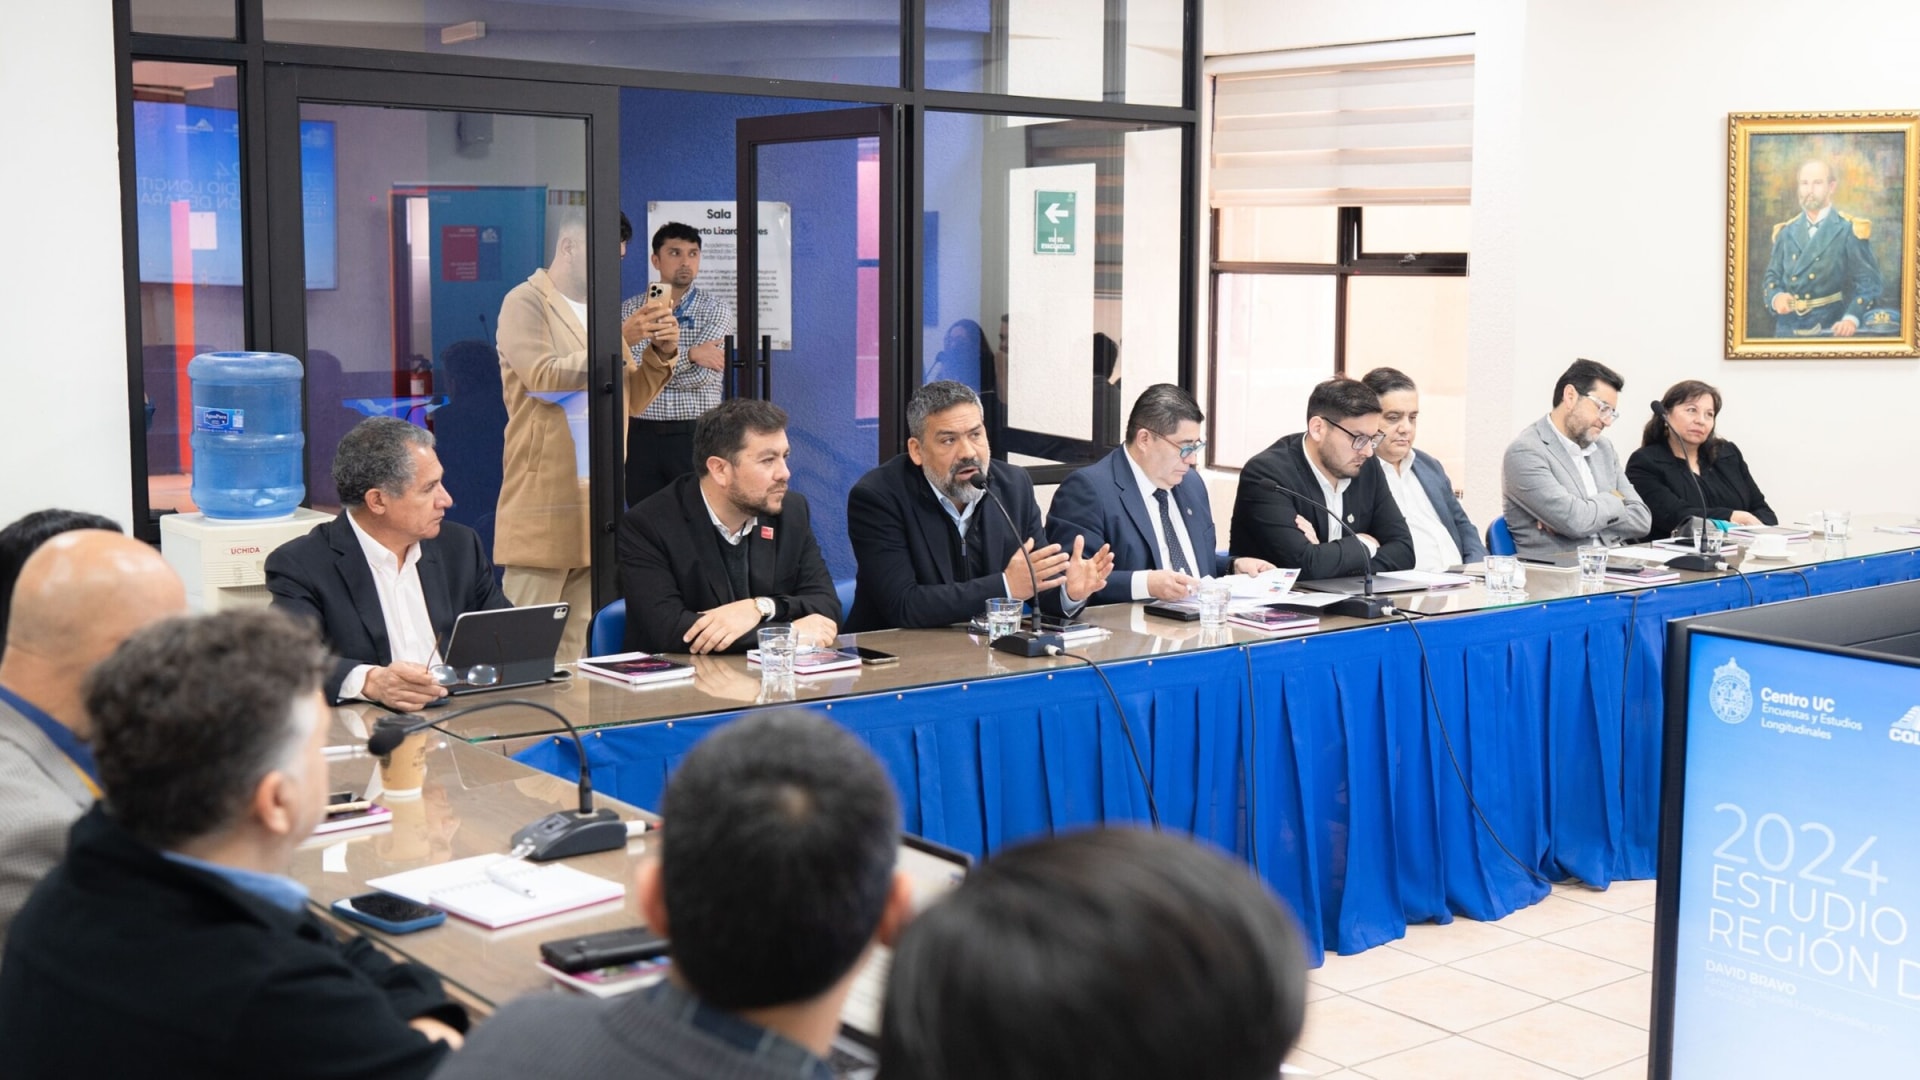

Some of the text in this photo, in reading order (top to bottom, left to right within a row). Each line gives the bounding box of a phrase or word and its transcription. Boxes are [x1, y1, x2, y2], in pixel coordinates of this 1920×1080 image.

[706, 208, 732, 219] Sala
[230, 546, 261, 555] UCHIDA
[1760, 687, 1836, 713] Centro UC
[1760, 717, 1833, 740] Longitudinales
[1761, 703, 1863, 731] Encuestas y Estudios
[1712, 802, 1889, 896] 2024
[1711, 863, 1908, 946] ESTUDIO
[1709, 907, 1879, 989] REGIÓN
[1705, 959, 1797, 996] DAVID BRAVO
